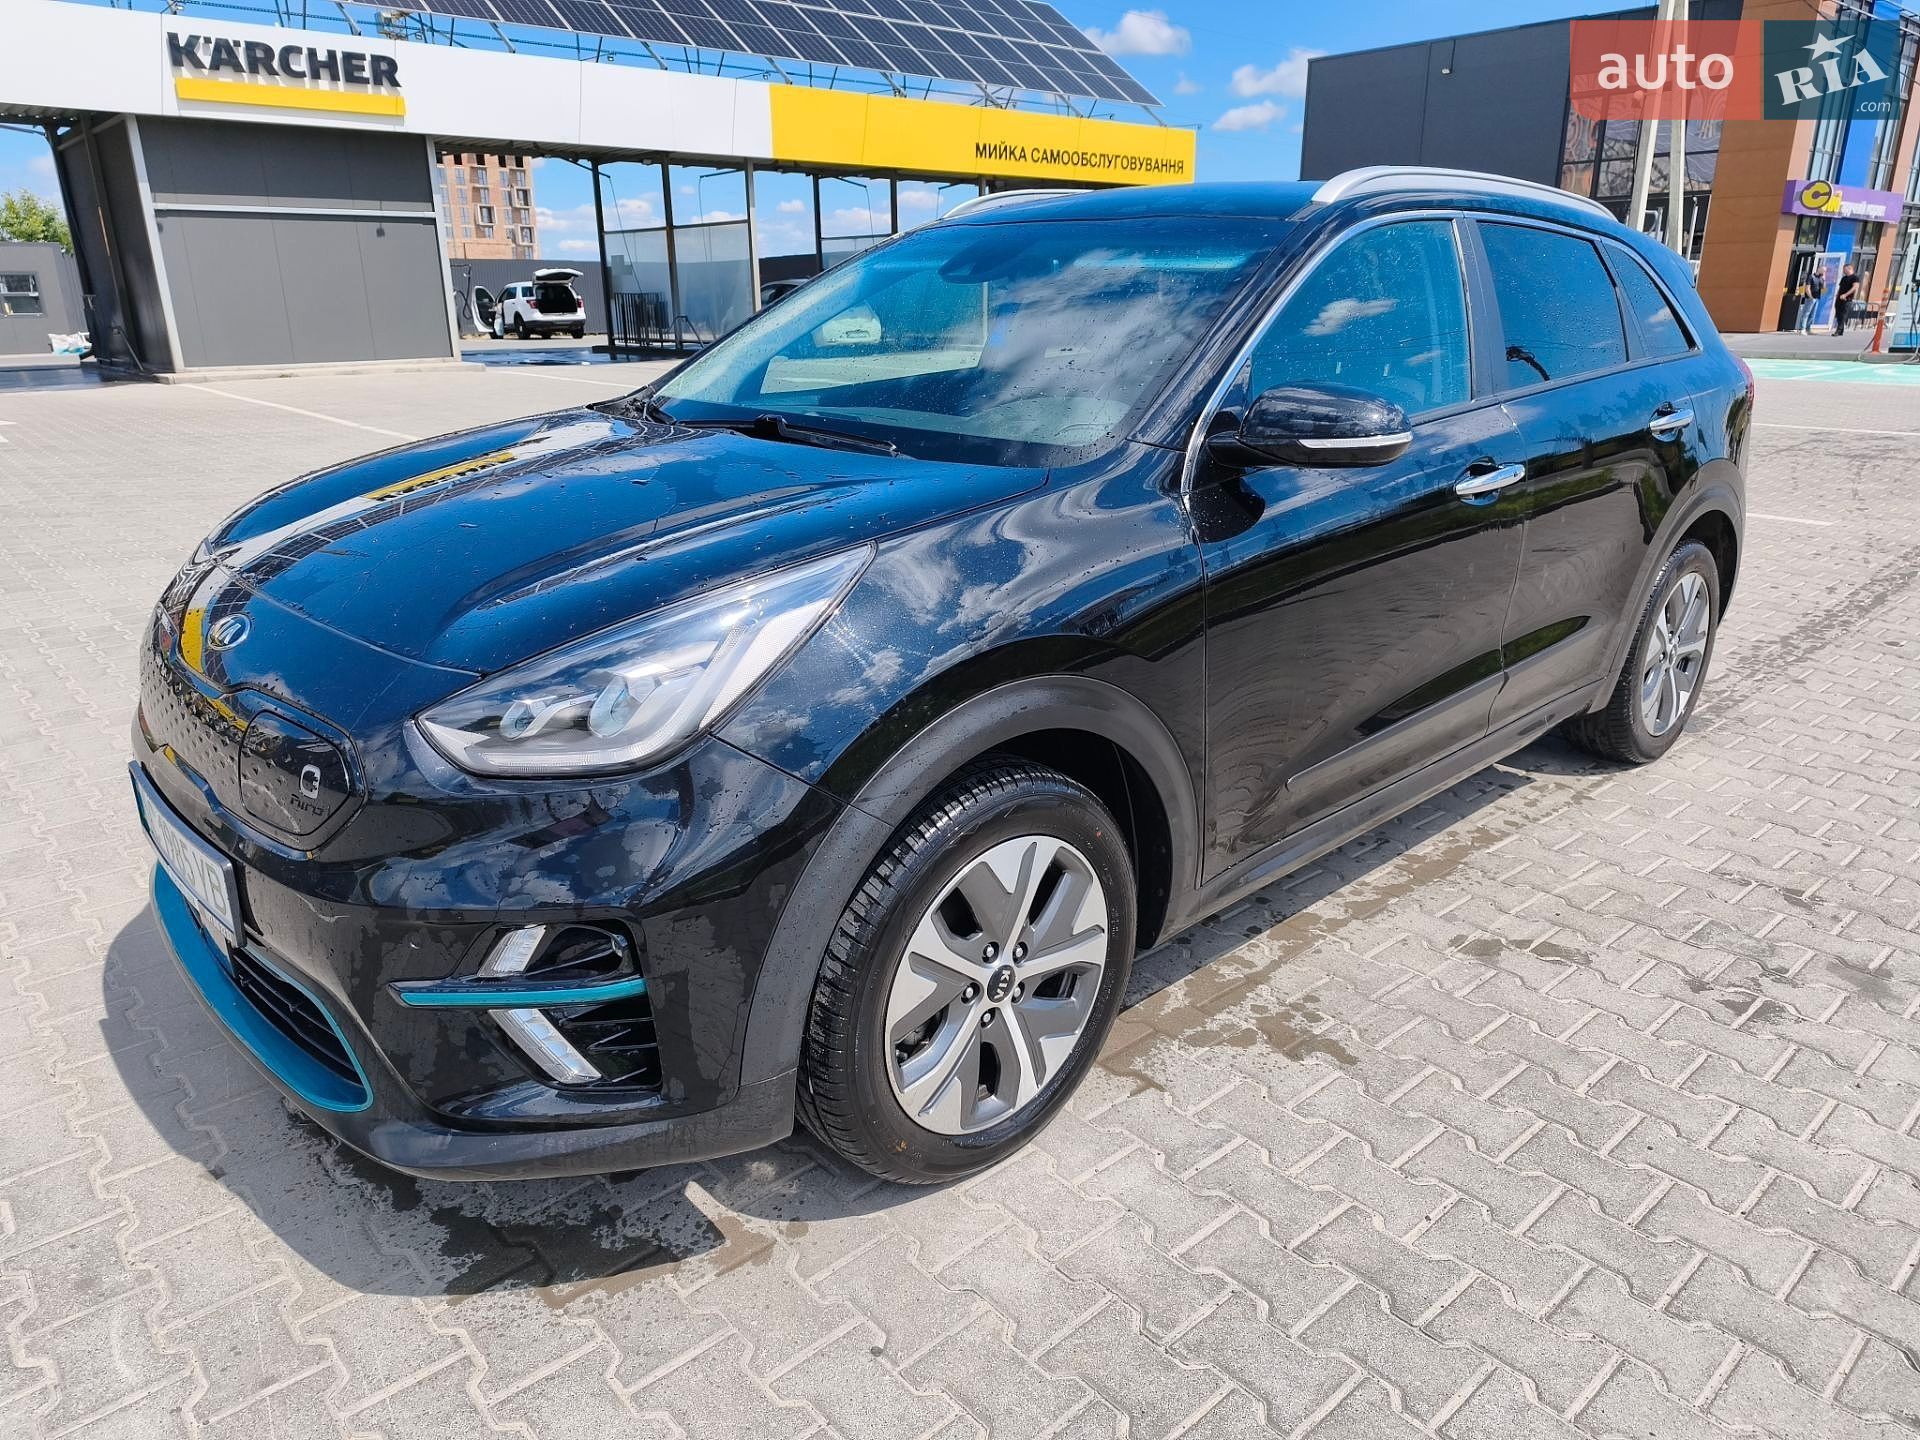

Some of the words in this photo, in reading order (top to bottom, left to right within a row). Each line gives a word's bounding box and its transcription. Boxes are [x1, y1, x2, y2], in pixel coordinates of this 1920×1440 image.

[167, 32, 402, 87] KÄRCHER
[975, 140, 1027, 162] МИЙКА
[1031, 147, 1184, 175] САМООБСЛУГОВУВАННЯ
[993, 969, 1011, 999] KIA
